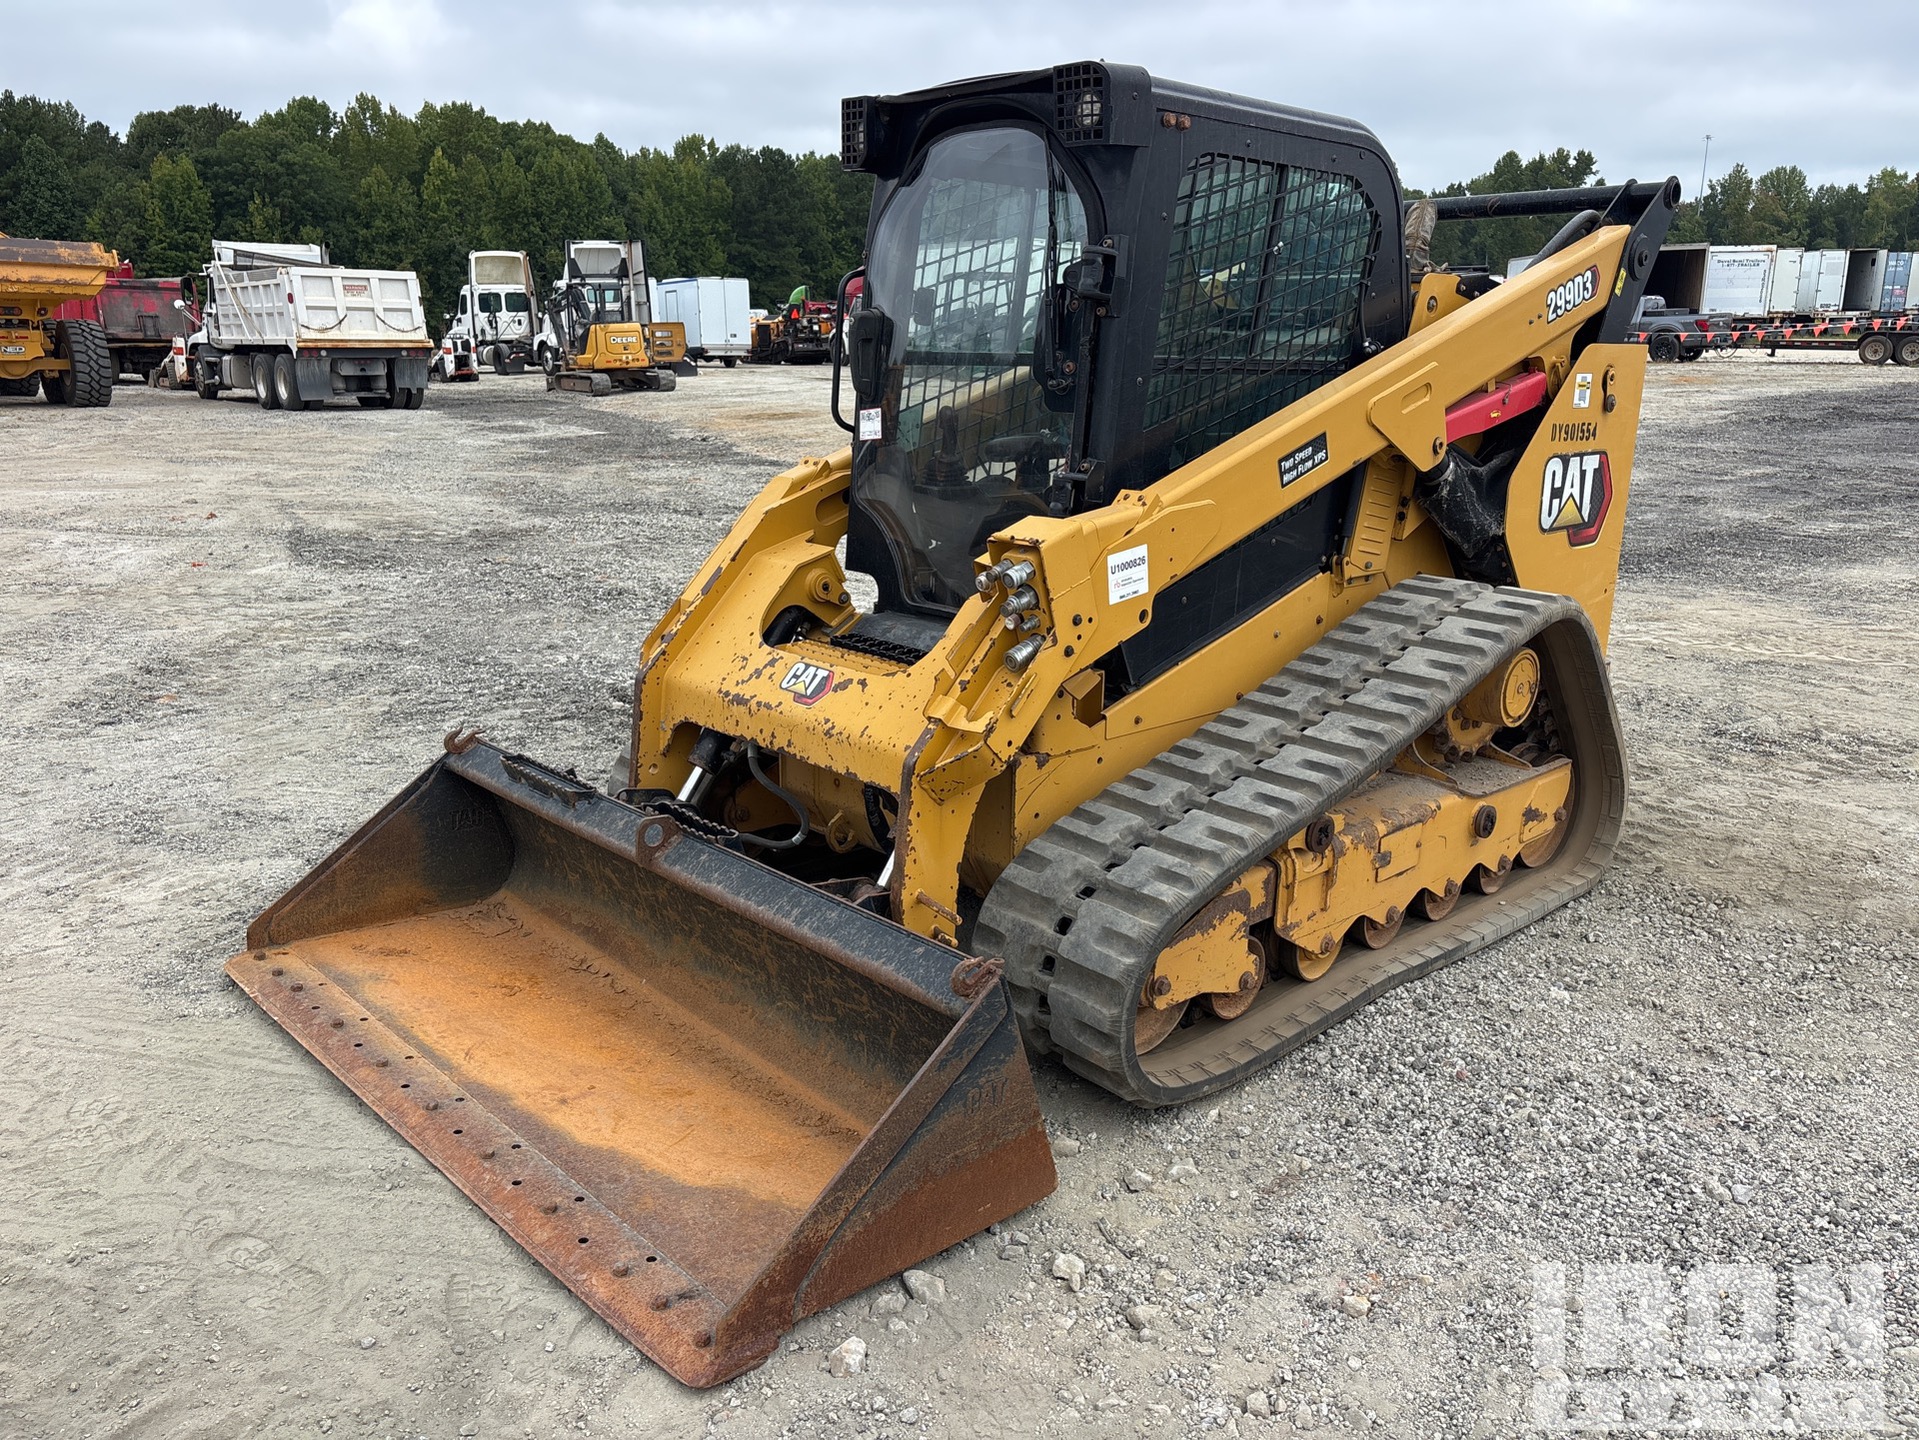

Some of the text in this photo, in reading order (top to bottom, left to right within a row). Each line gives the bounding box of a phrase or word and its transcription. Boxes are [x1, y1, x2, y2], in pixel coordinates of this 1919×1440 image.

[1547, 270, 1592, 322] 299D3
[1551, 422, 1597, 442] DY901554
[1313, 449, 1326, 466] XPS
[1540, 454, 1601, 530] CAT
[1110, 555, 1146, 575] U1000826
[780, 661, 830, 697] CAT
